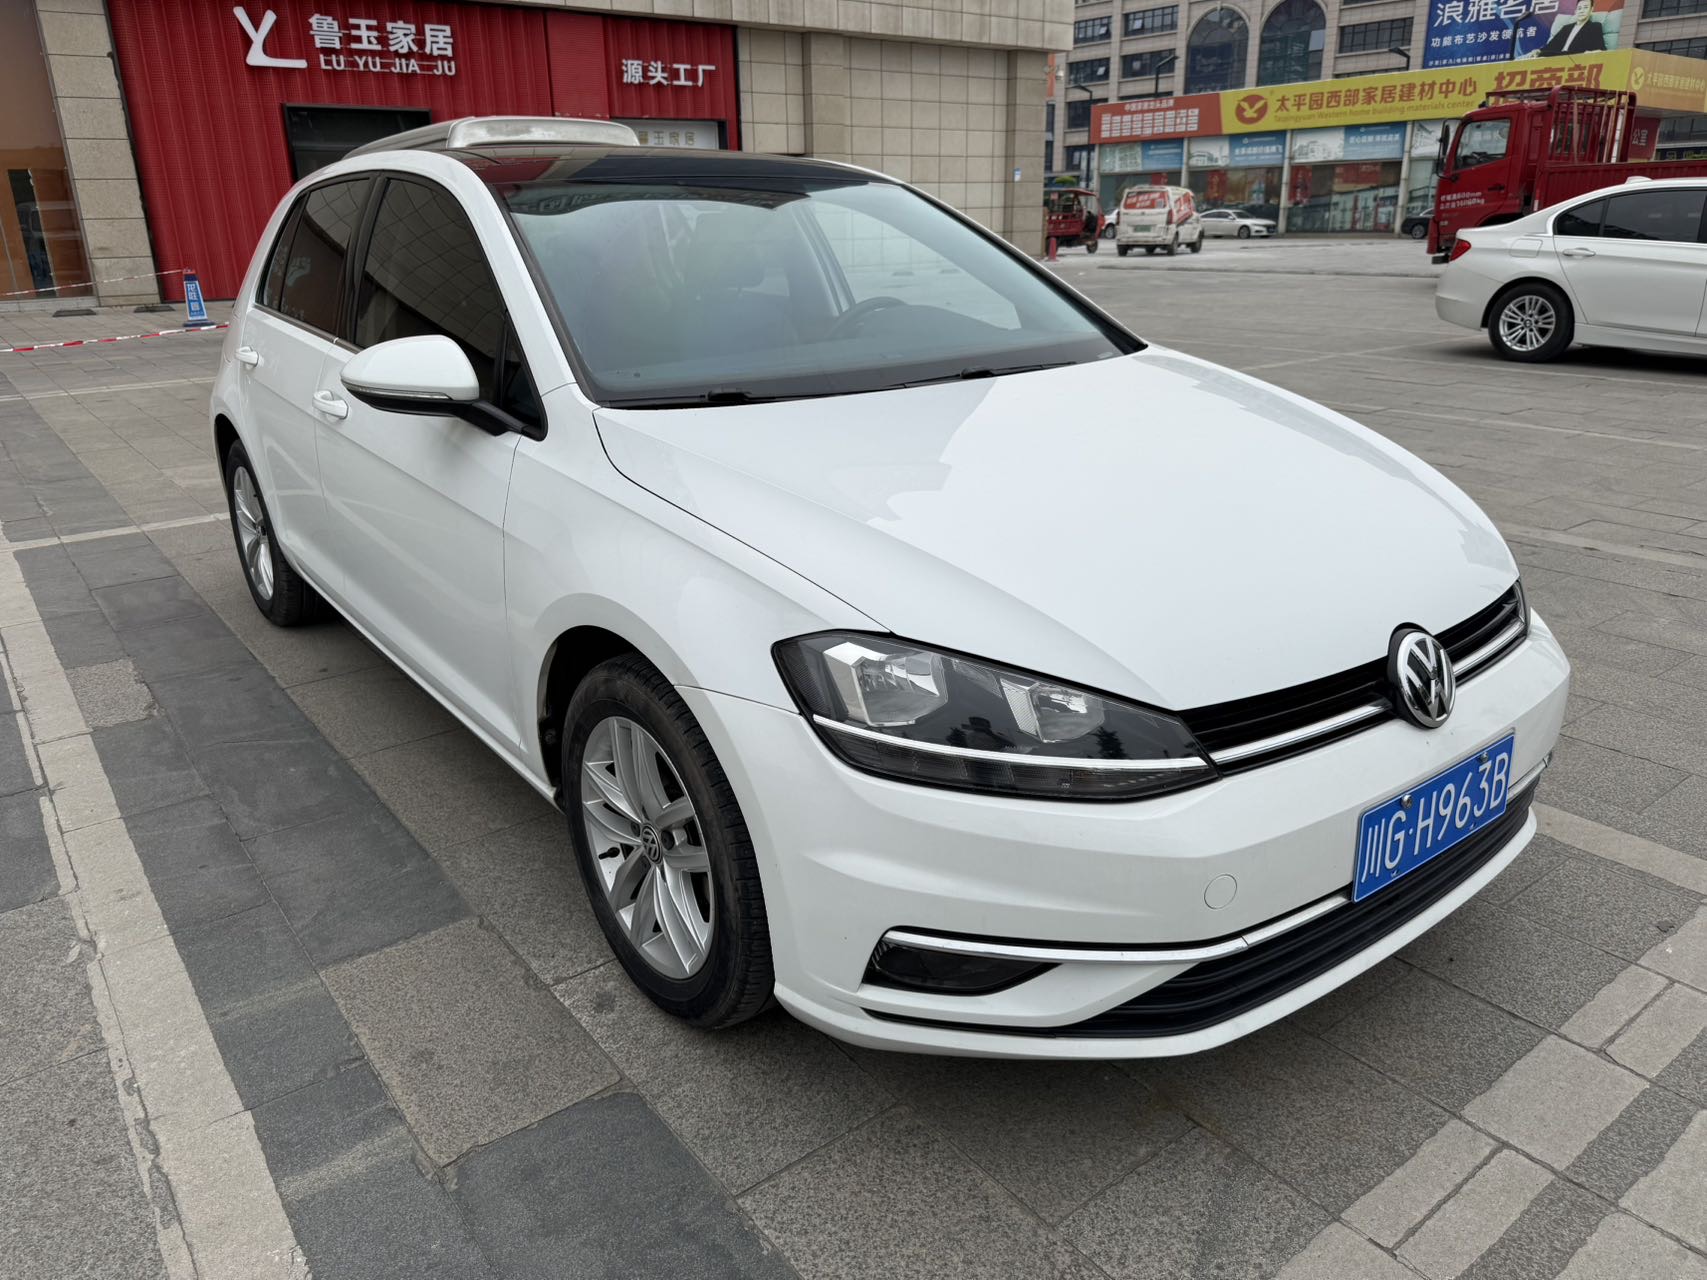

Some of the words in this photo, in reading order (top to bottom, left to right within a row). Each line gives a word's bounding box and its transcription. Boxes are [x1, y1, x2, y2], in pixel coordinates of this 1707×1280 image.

[308, 13, 454, 57] 鲁玉家居
[319, 53, 345, 70] LU
[354, 56, 381, 72] YU
[391, 57, 420, 74] JIA
[433, 60, 456, 76] JU
[621, 58, 716, 87] 源头工厂
[1274, 77, 1477, 113] 太平园西部家居建材中心
[1493, 63, 1604, 104] 招商部
[1372, 105, 1405, 116] building
[1406, 102, 1445, 112] materials
[1446, 99, 1475, 109] center
